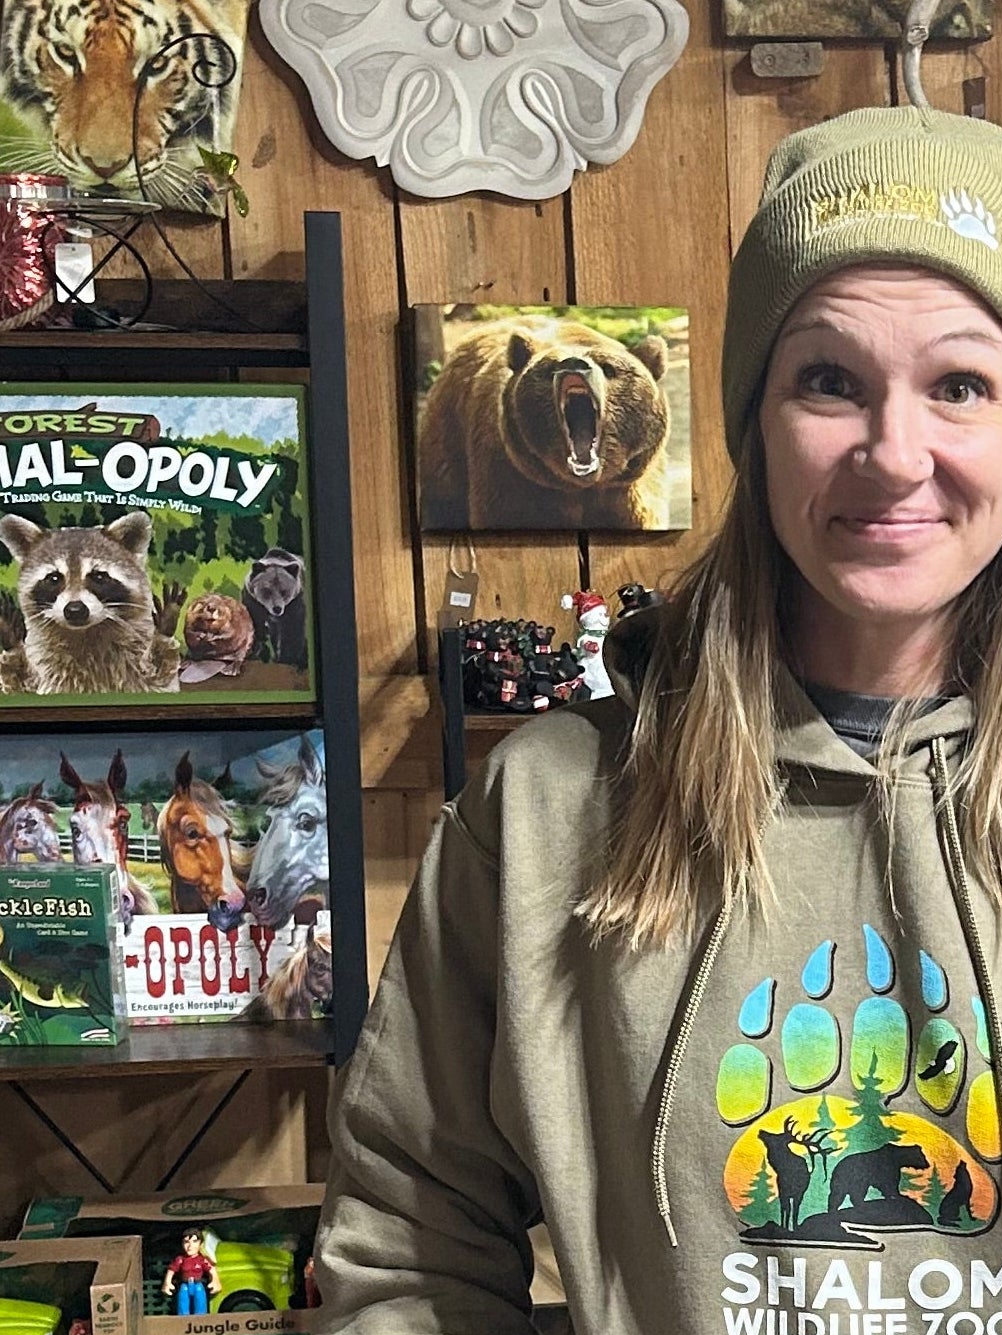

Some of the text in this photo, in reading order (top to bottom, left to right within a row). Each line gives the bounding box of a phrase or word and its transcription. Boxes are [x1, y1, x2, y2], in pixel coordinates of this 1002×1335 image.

[0, 414, 144, 434] OREST
[52, 490, 82, 503] GAME
[84, 491, 114, 503] THAT
[128, 494, 166, 509] SIMPLY
[0, 899, 92, 916] ckleFish
[125, 925, 275, 998] -OPOLY
[131, 998, 239, 1014] Encourages Horseplay!
[185, 1317, 296, 1335] Jungle Guide
